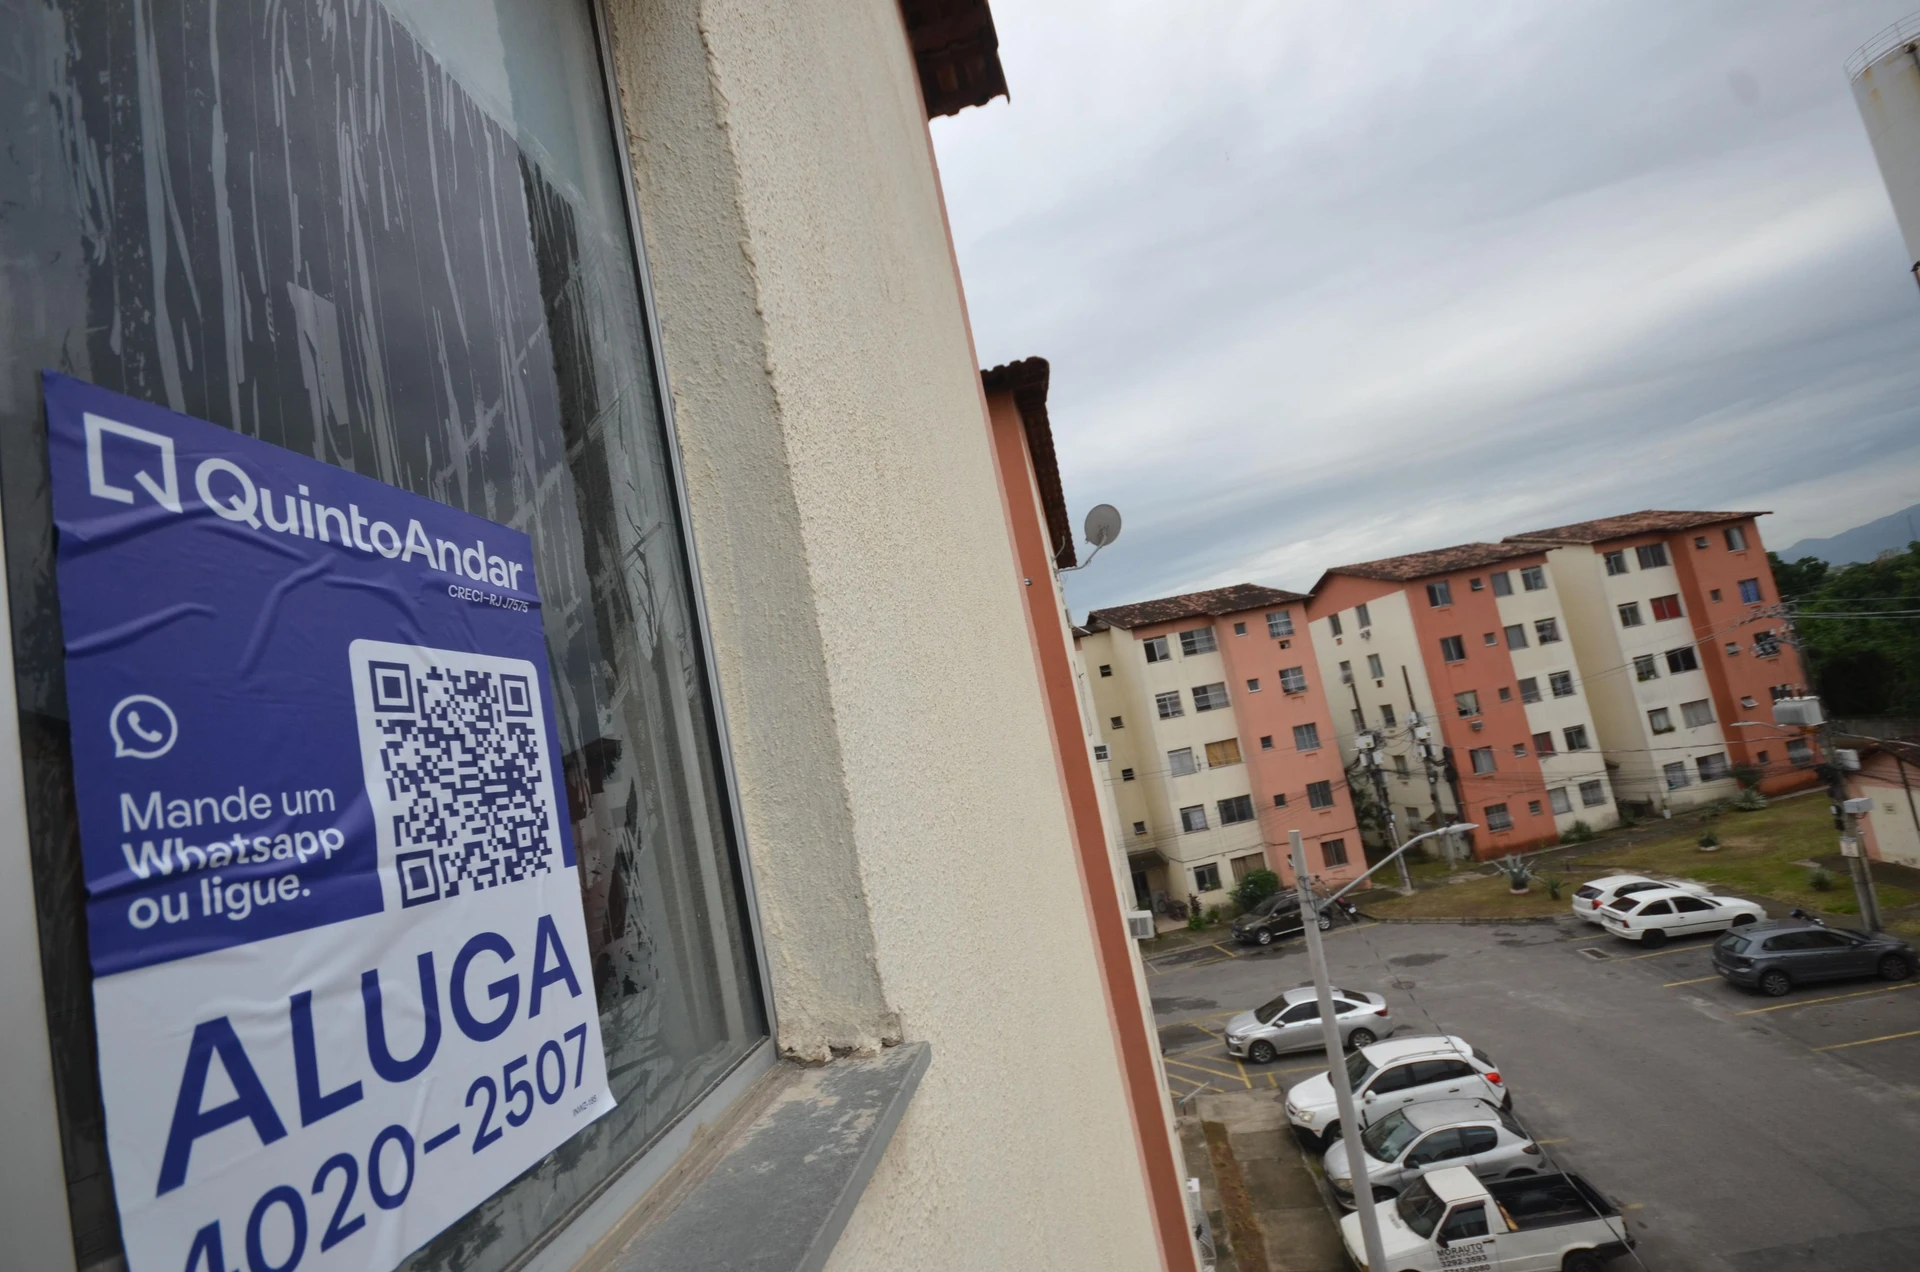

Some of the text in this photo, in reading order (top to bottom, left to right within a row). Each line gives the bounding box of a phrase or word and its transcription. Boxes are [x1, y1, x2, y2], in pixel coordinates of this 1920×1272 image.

[194, 457, 524, 591] QuintoAndar
[448, 584, 529, 613] CRECI-RJ J7575
[119, 785, 336, 834] Mande um
[121, 826, 345, 880] Whatsapp
[127, 874, 311, 930] ou ligue.
[154, 913, 583, 1199] ALUGA
[1437, 1243, 1483, 1256] MORAUTO
[1441, 1254, 1487, 1267] 3292-3593
